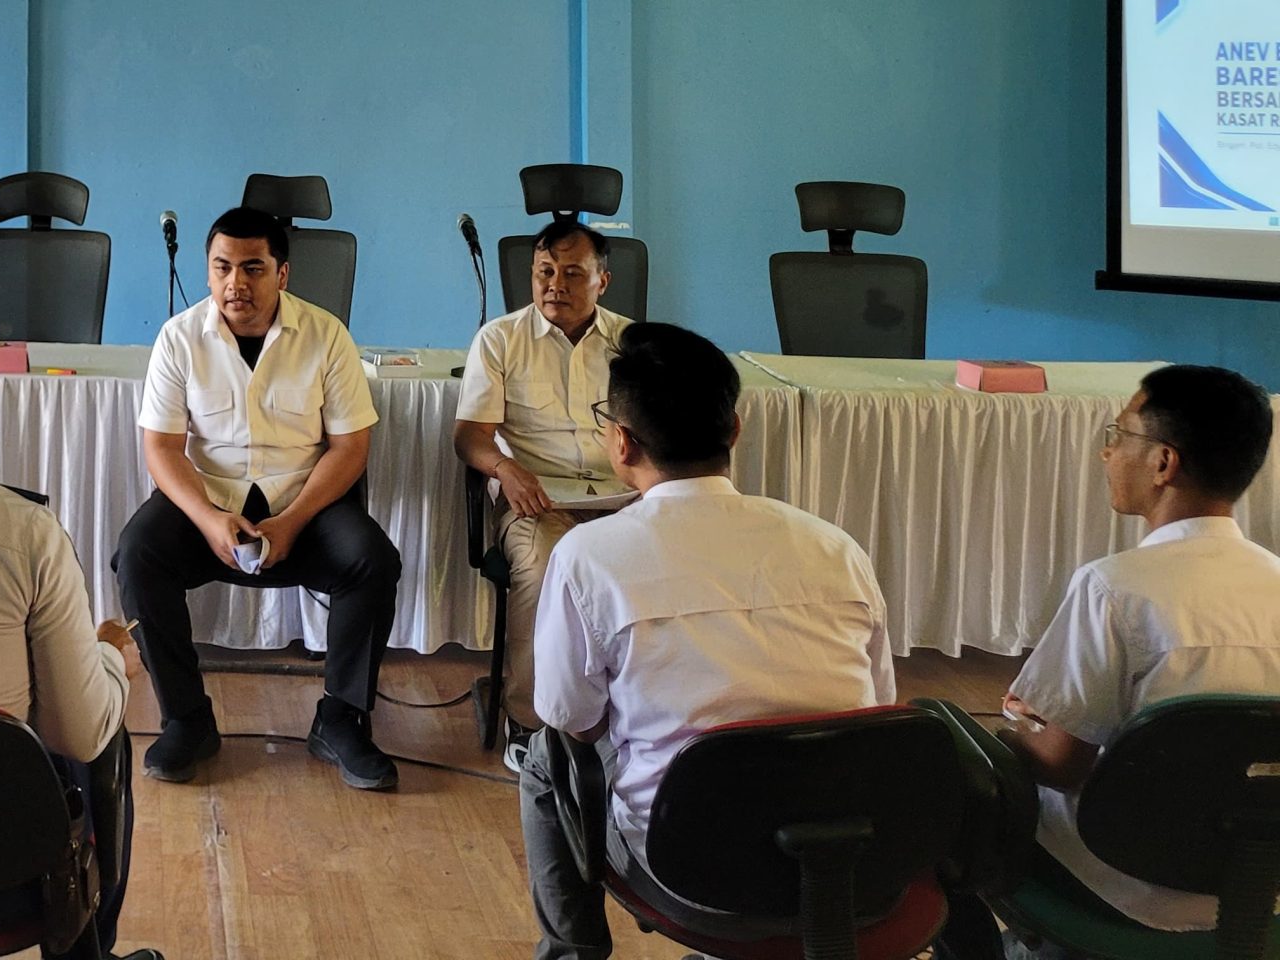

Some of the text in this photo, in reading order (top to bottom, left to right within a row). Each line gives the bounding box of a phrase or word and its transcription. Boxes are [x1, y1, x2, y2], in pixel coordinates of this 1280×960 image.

[1216, 42, 1269, 61] ANEV
[1216, 66, 1280, 86] BARE
[1217, 91, 1280, 108] BERSA
[1217, 112, 1266, 127] KASAT
